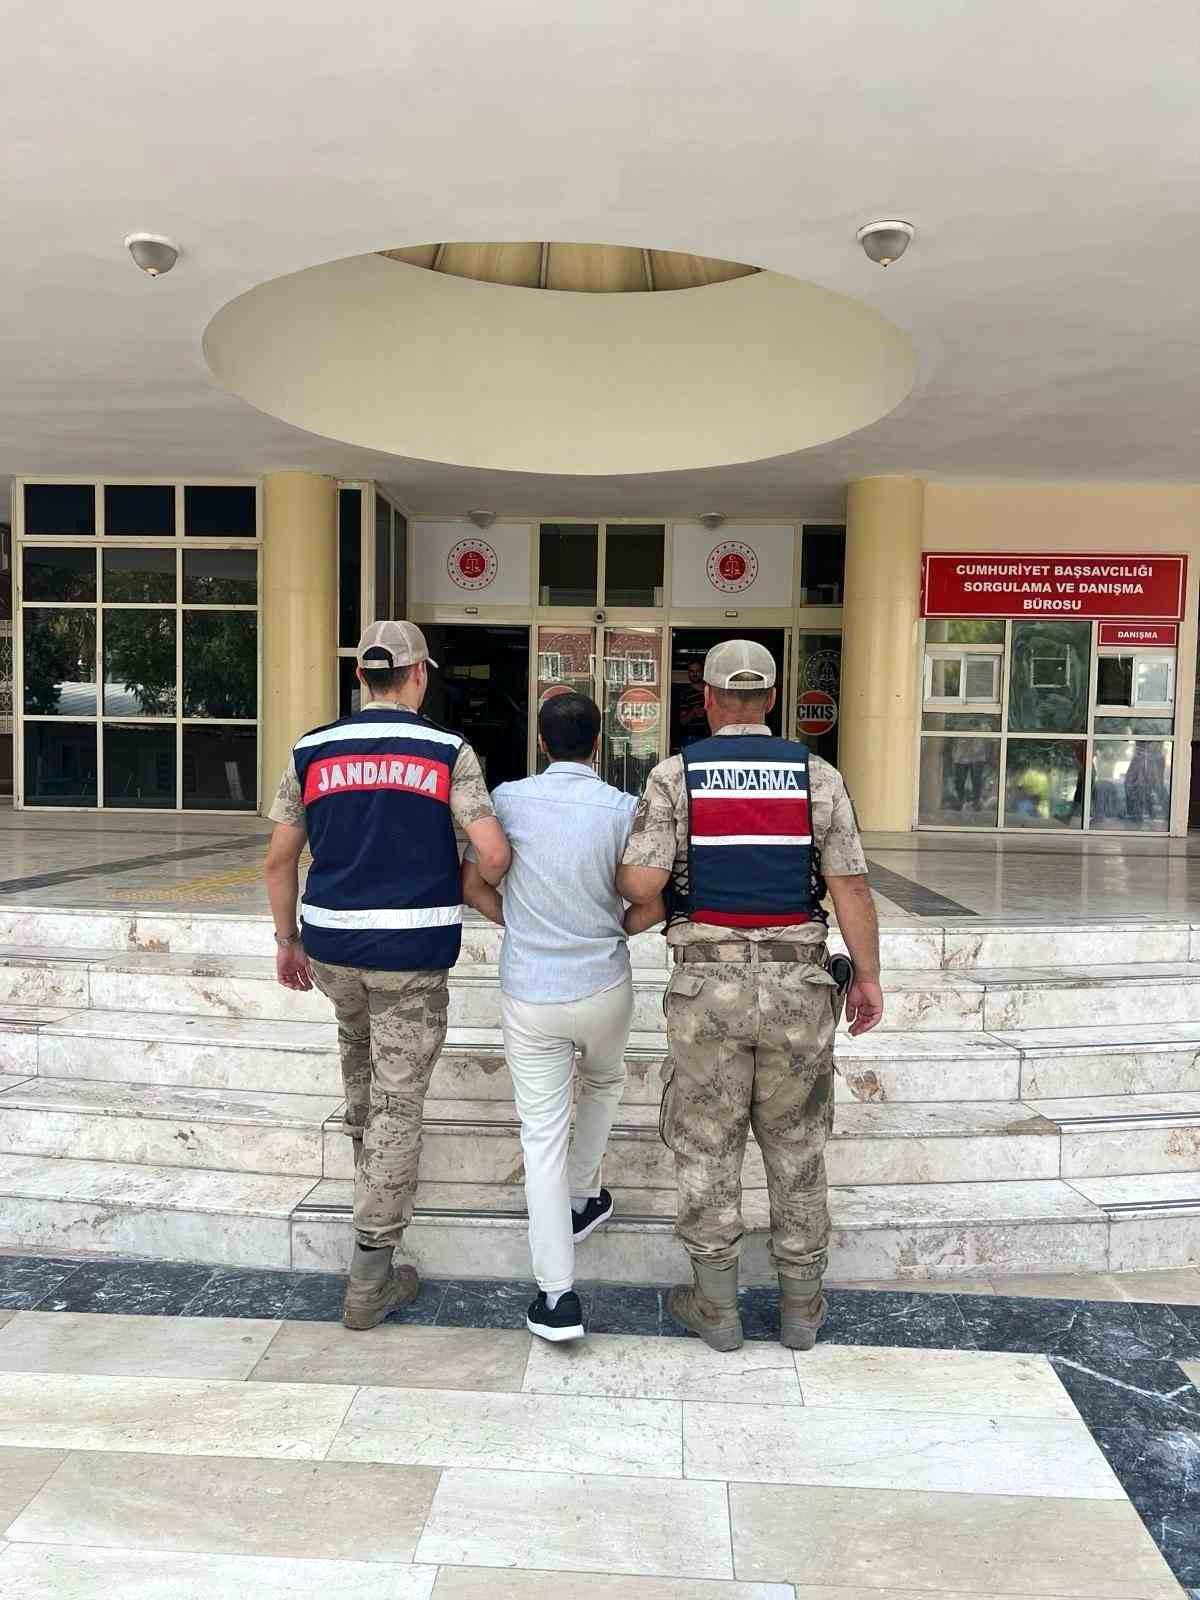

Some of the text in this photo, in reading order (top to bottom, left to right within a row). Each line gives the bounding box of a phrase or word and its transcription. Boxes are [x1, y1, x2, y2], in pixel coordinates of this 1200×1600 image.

[956, 563, 1153, 579] CUMHURİYET BAŞSAVCILIĞI
[963, 582, 1144, 596] SORGULAMA VE DANIŞMA
[1023, 597, 1082, 610] BÜROSU
[1117, 631, 1158, 640] DANIŞMA
[318, 761, 438, 794] JANDARMA
[700, 768, 799, 790] JANDARMA
